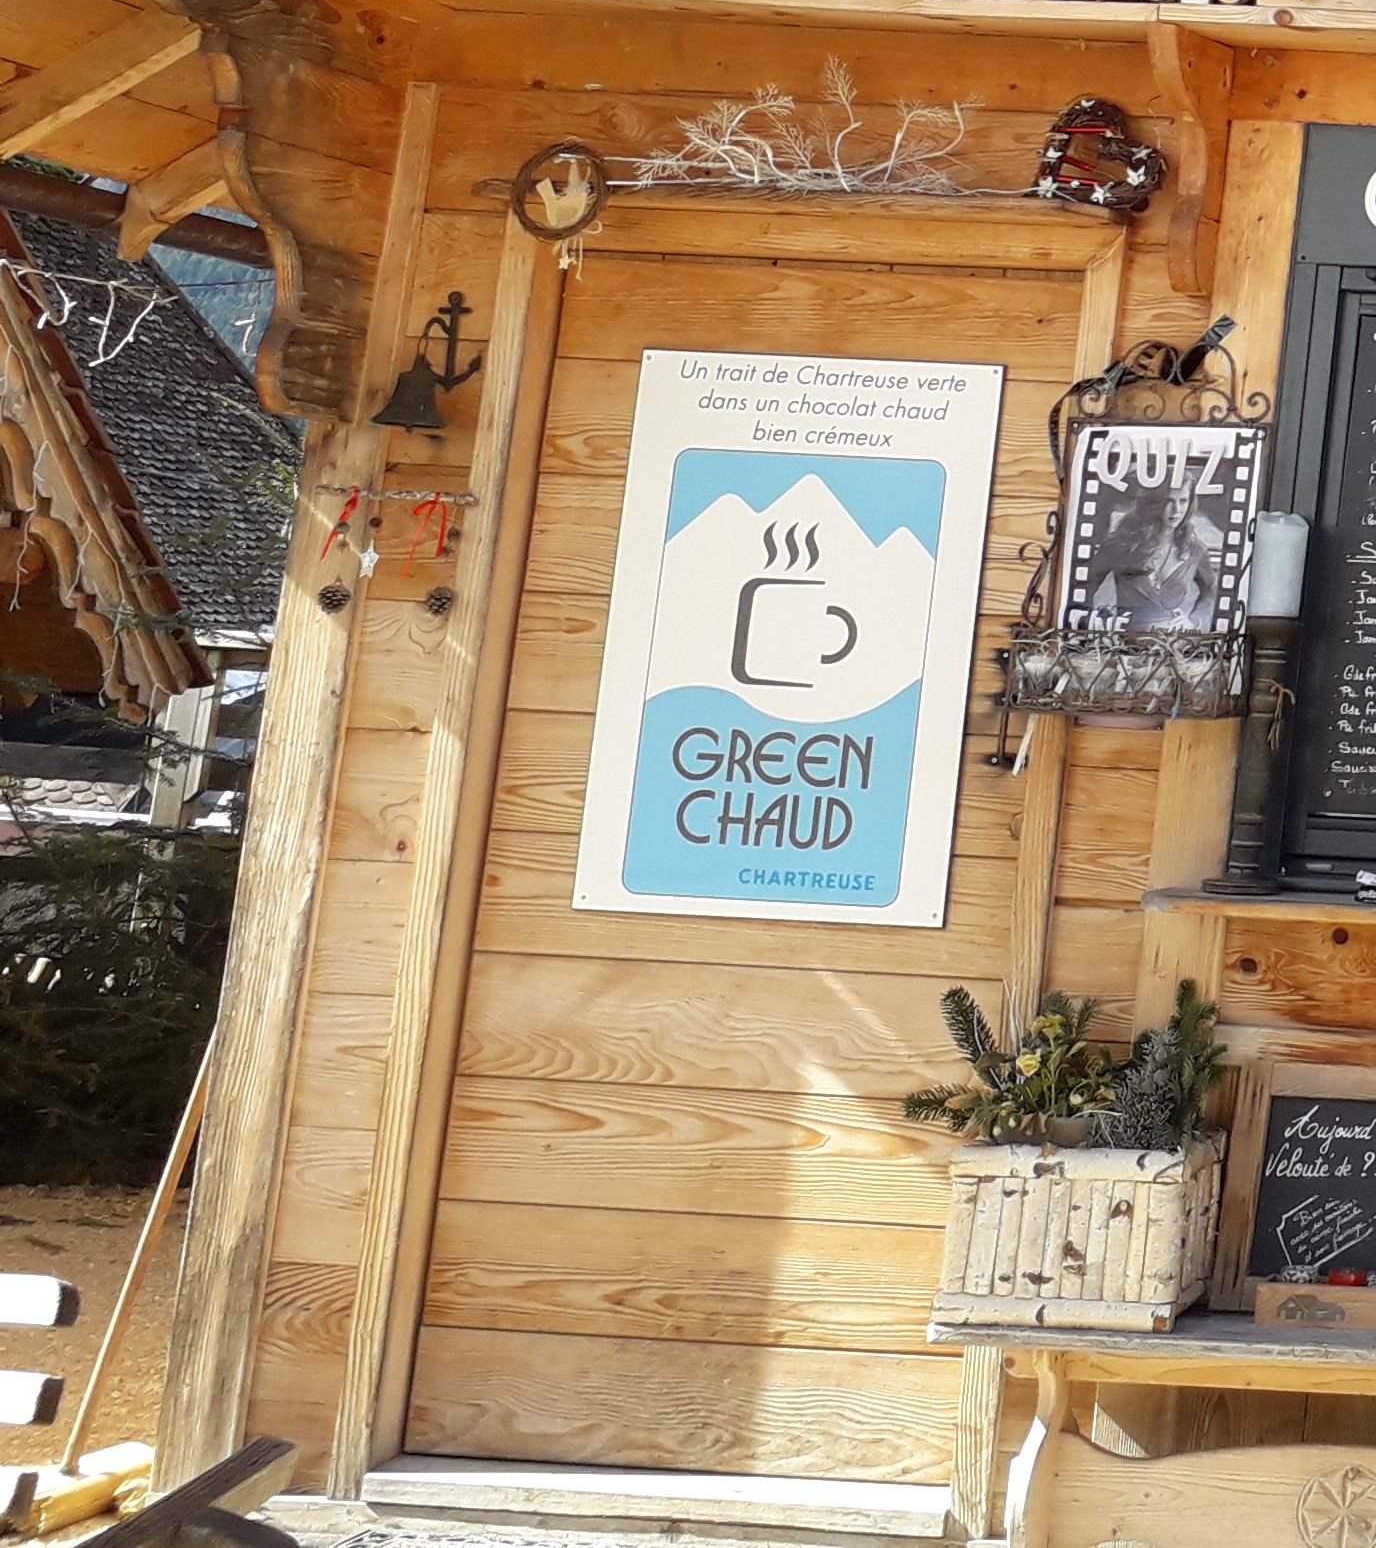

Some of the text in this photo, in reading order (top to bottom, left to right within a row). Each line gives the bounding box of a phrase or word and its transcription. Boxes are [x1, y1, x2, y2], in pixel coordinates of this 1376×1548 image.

[679, 359, 967, 393] Un trait de Chartreuse verte
[698, 388, 950, 421] dans un chocolat chaud
[752, 420, 894, 448] bien crémeux
[1097, 433, 1227, 495] QUIZ
[671, 726, 875, 791] GREEN
[675, 789, 853, 851] CHAUD
[737, 867, 877, 892] CHARTREUSE
